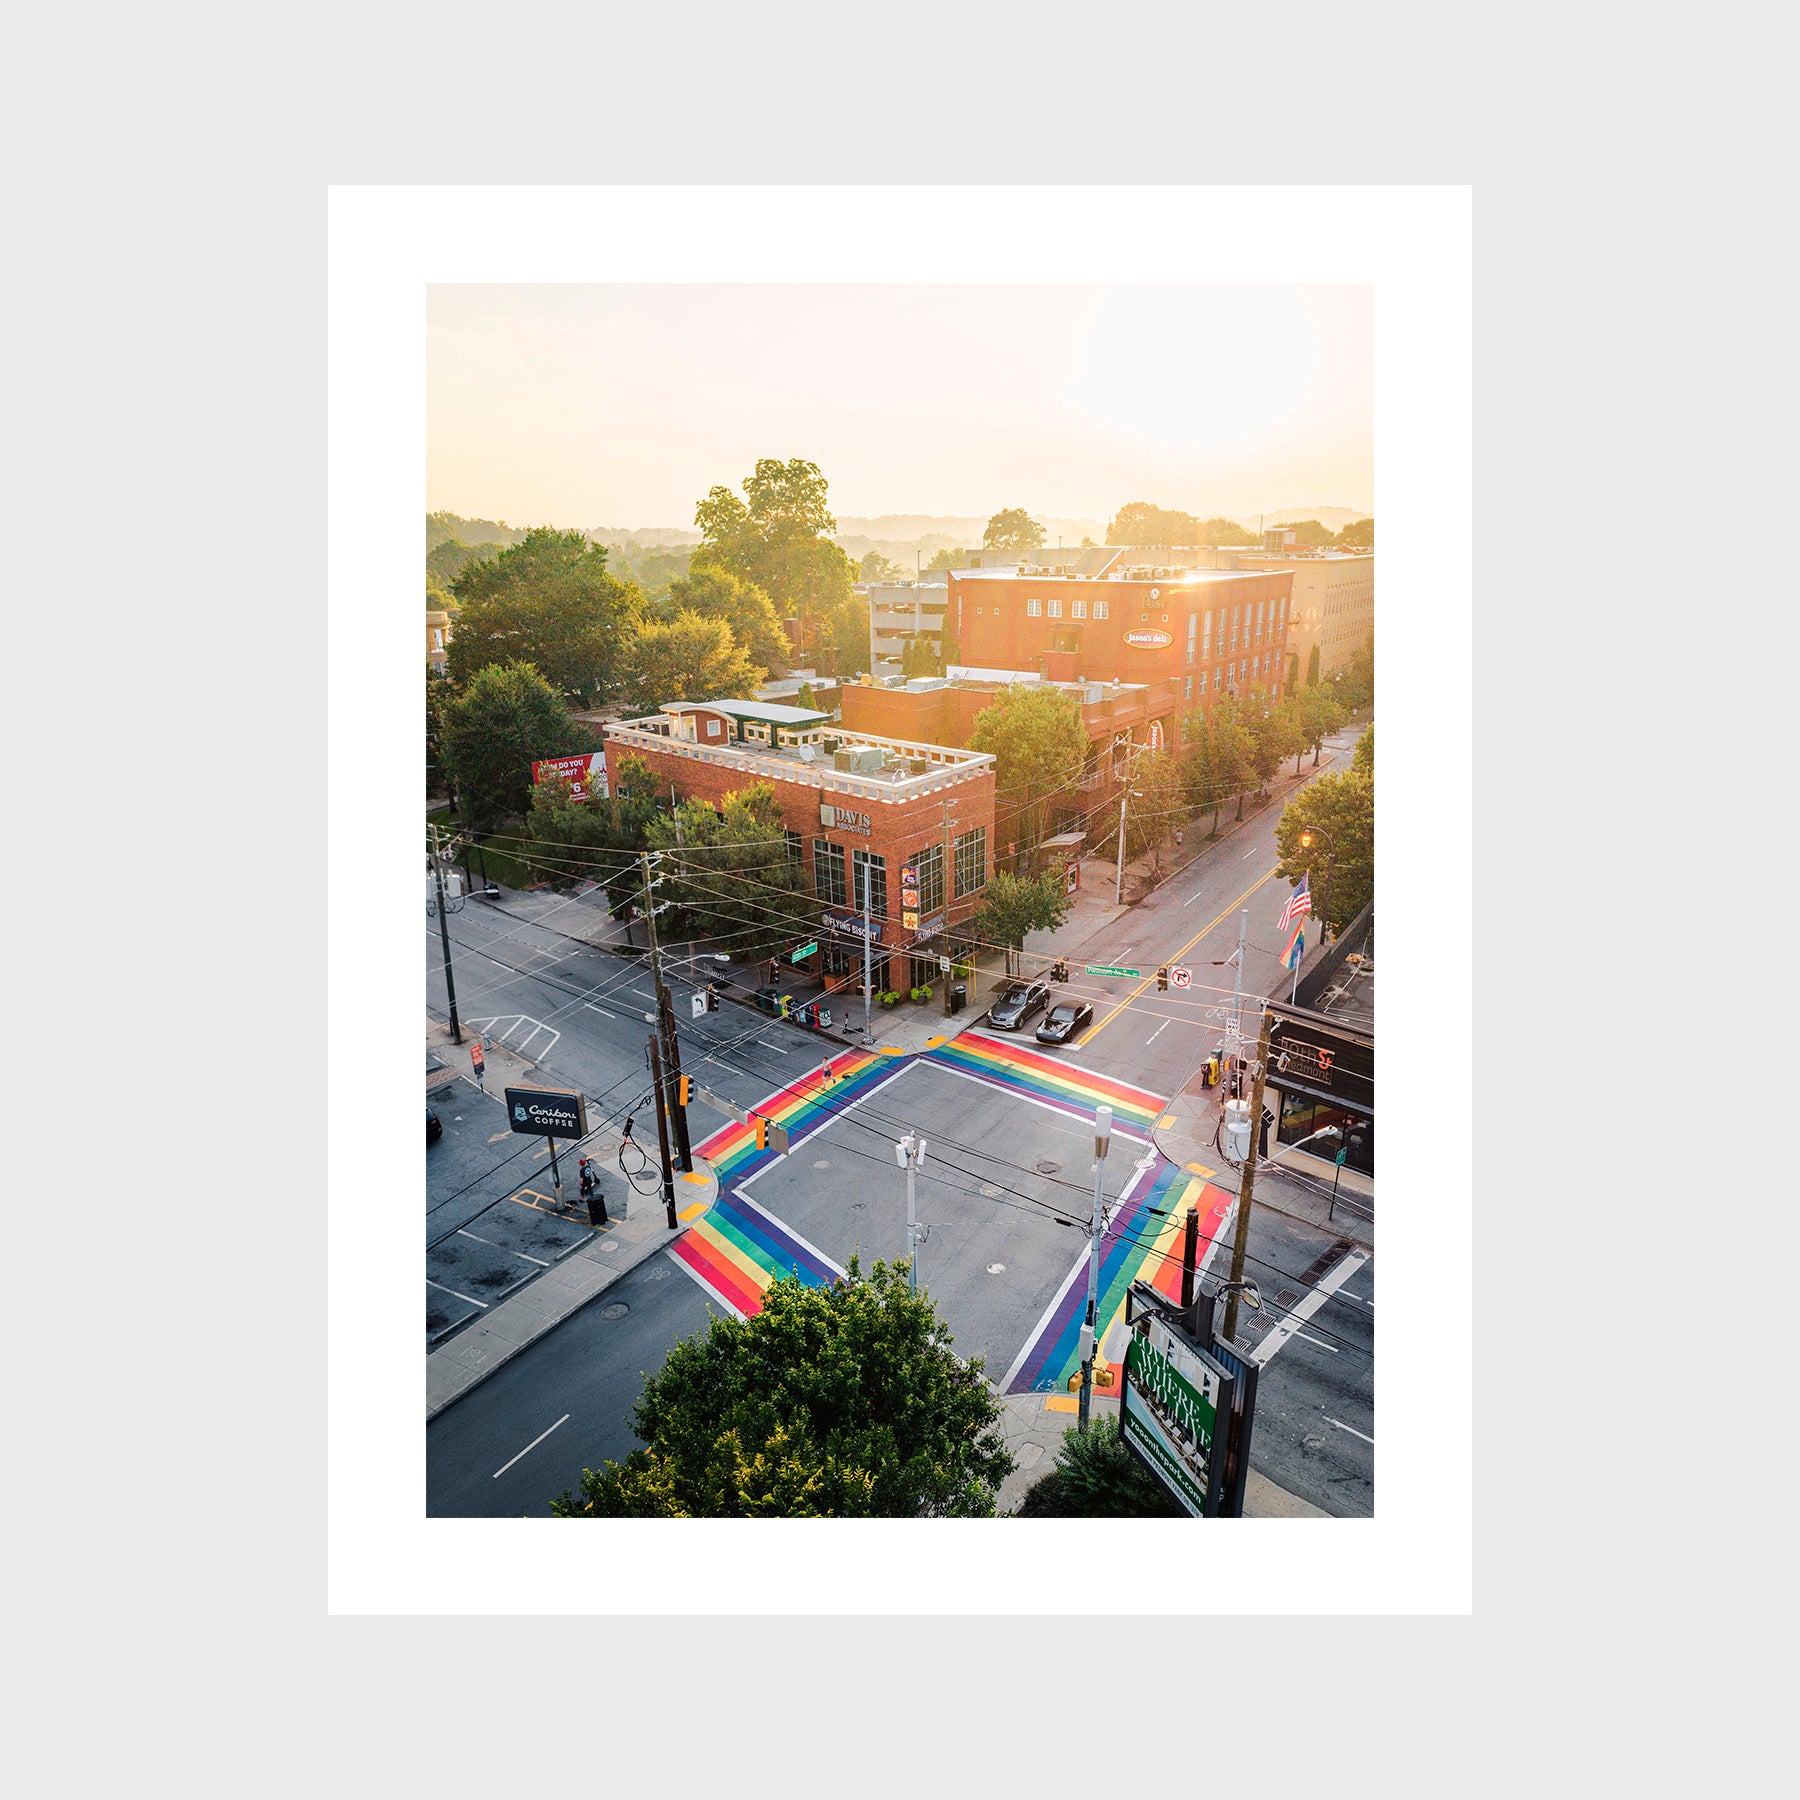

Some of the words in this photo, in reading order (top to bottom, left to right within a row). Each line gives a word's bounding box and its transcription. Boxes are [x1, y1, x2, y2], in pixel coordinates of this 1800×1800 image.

[1152, 634, 1167, 643] deli
[558, 761, 569, 769] DO
[569, 759, 584, 767] YOU
[835, 806, 871, 829] DAVIS
[829, 917, 851, 932] FLYING
[851, 924, 878, 942] BISCIT
[1227, 1018, 1239, 1026] ONE
[528, 1104, 577, 1120] Caribou
[534, 1116, 574, 1128] COFFEE
[1132, 1325, 1172, 1378] LOVE
[1140, 1346, 1201, 1423] WHERE
[1173, 1400, 1212, 1452] LIVE
